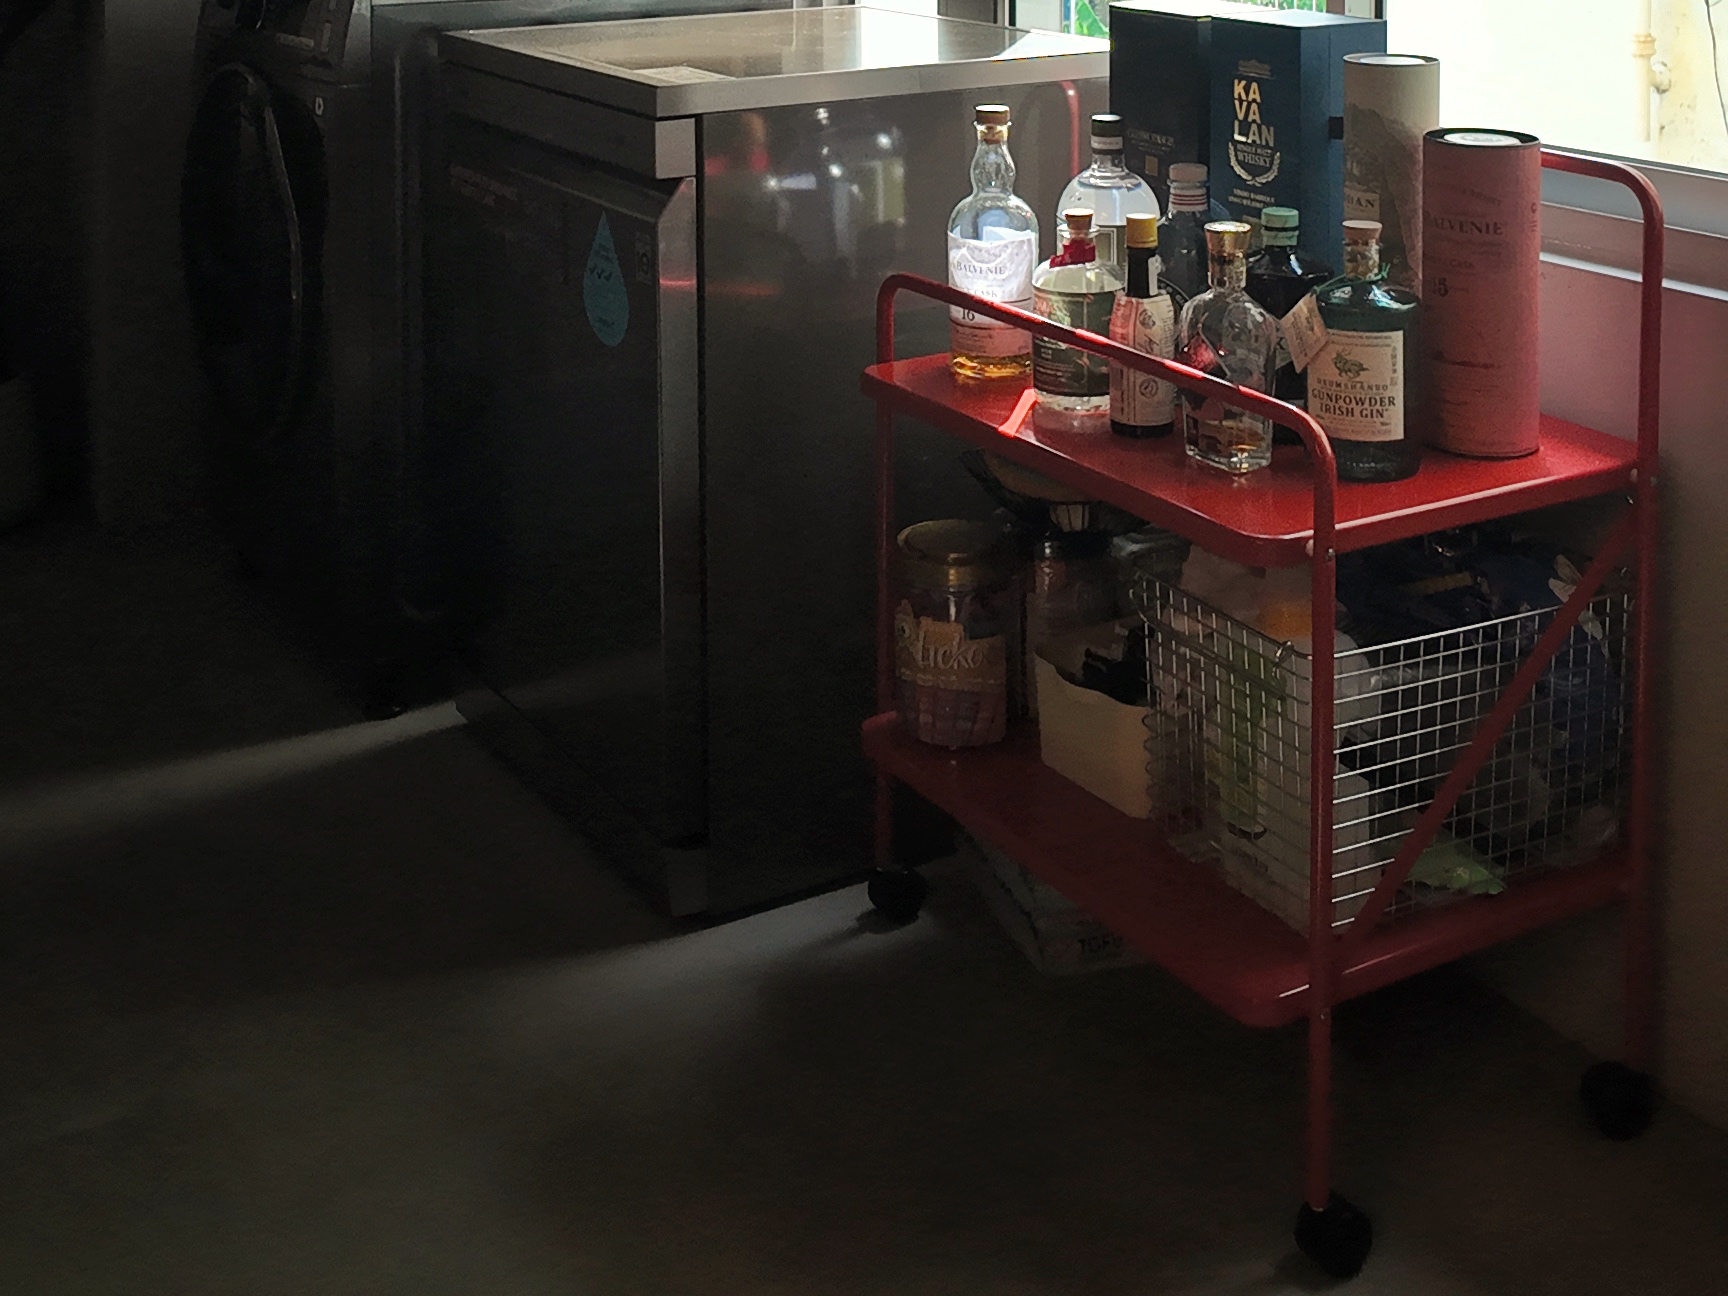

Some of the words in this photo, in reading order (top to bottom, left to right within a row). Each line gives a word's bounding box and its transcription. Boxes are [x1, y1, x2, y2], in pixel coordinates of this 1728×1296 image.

[1233, 78, 1262, 103] KA
[1234, 99, 1262, 124] VA
[1233, 119, 1275, 147] LAN
[1236, 151, 1272, 168] WHISKY
[961, 308, 976, 322] 16
[1311, 387, 1397, 408] GUNPOWDER
[1320, 403, 1355, 418] IRISH
[1359, 407, 1385, 419] GIN
